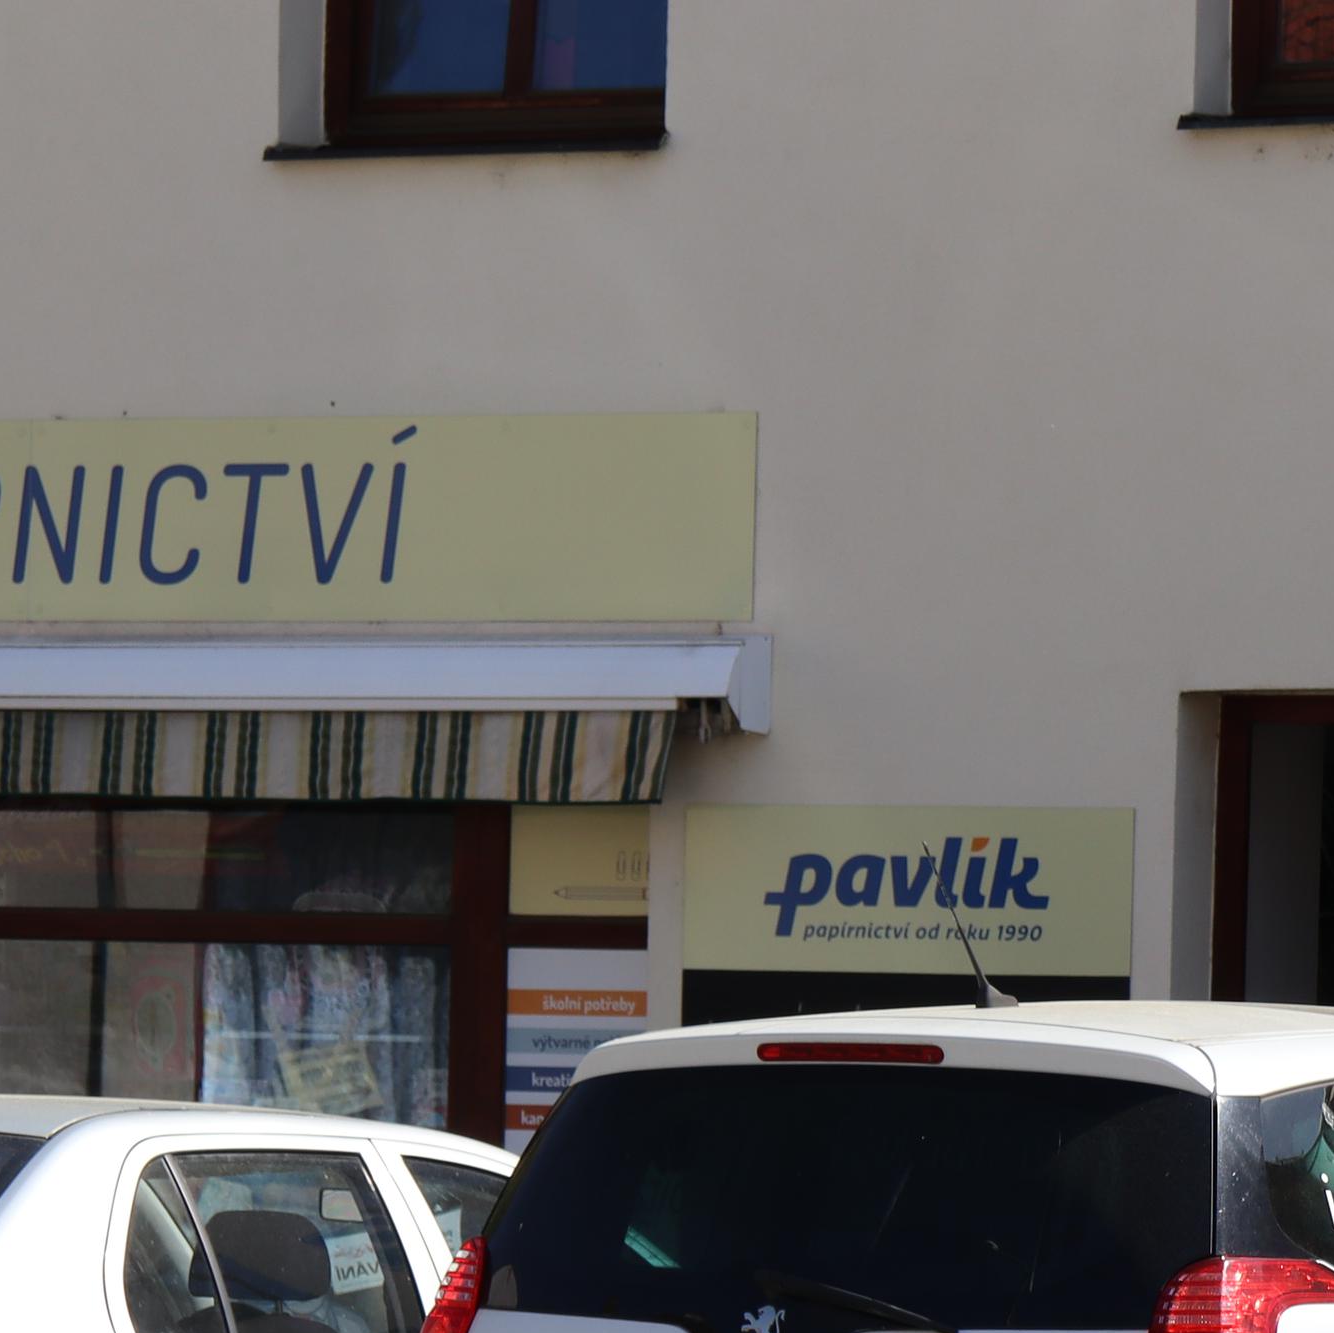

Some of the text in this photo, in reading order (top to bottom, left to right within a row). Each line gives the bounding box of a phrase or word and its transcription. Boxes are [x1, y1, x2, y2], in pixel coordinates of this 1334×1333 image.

[763, 837, 1050, 937] pavlík
[803, 921, 1043, 943] papírnictví od roku 1990
[542, 994, 636, 1015] školní potřeby
[531, 1034, 590, 1051] výtvarné
[531, 1071, 572, 1087] kreati
[521, 1110, 545, 1126] kan
